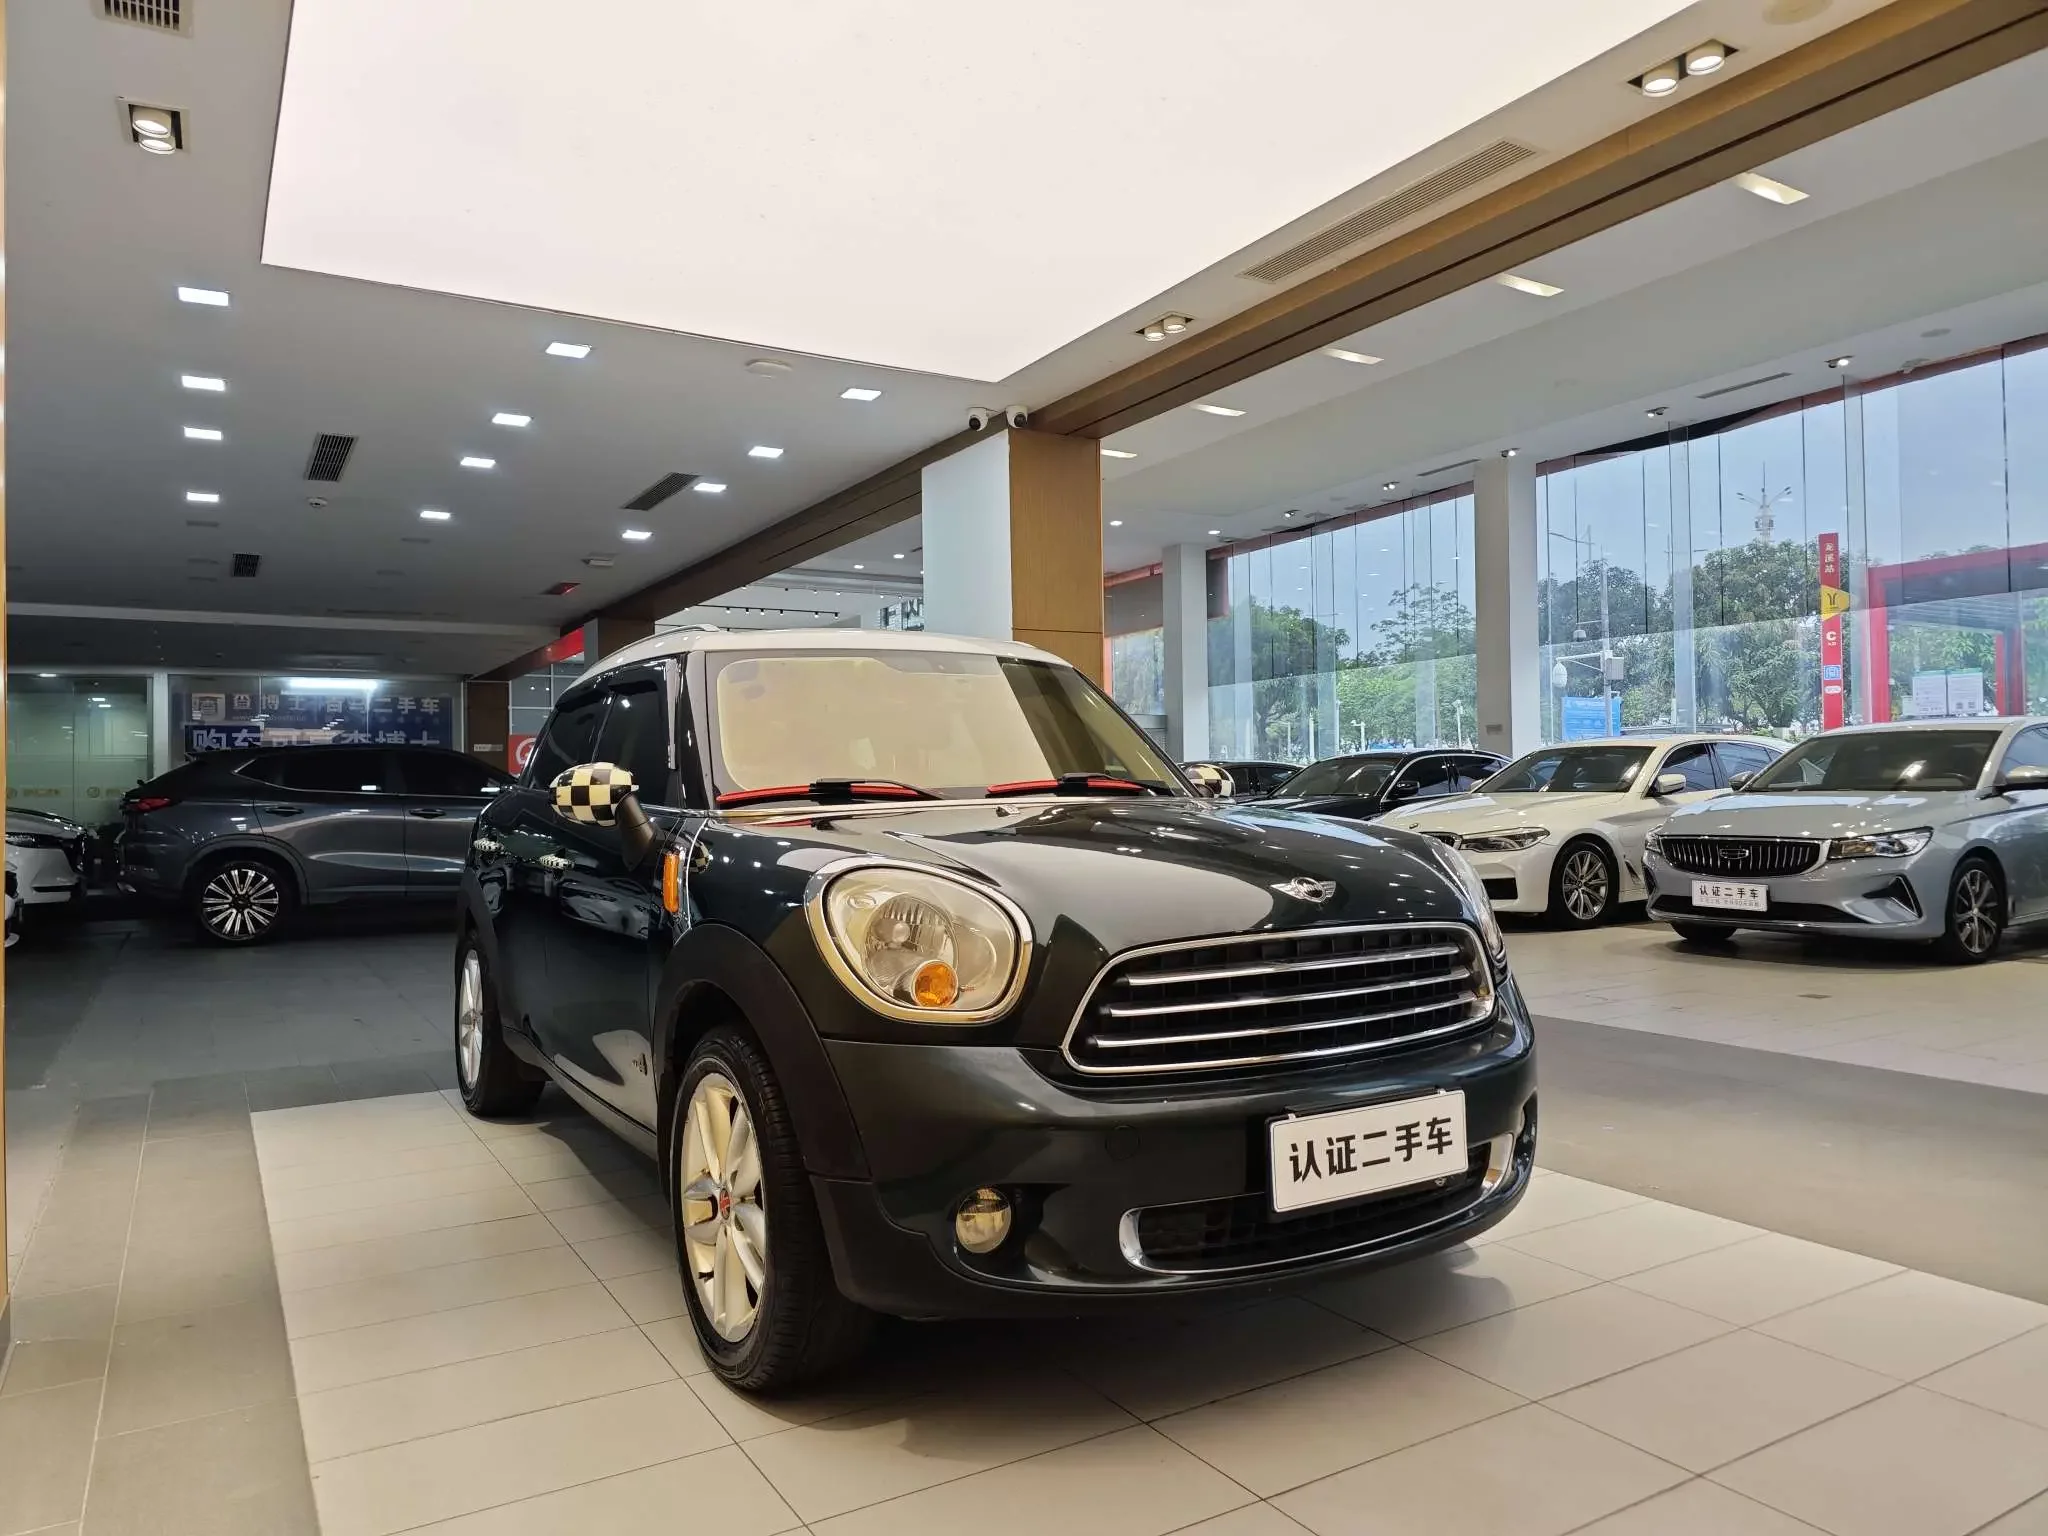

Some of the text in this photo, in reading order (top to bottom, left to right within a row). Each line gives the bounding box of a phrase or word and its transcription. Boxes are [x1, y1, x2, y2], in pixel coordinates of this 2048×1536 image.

[1826, 631, 1837, 641] C
[1699, 884, 1759, 899] 认证二手车
[1289, 1117, 1453, 1183] 认证二手车
